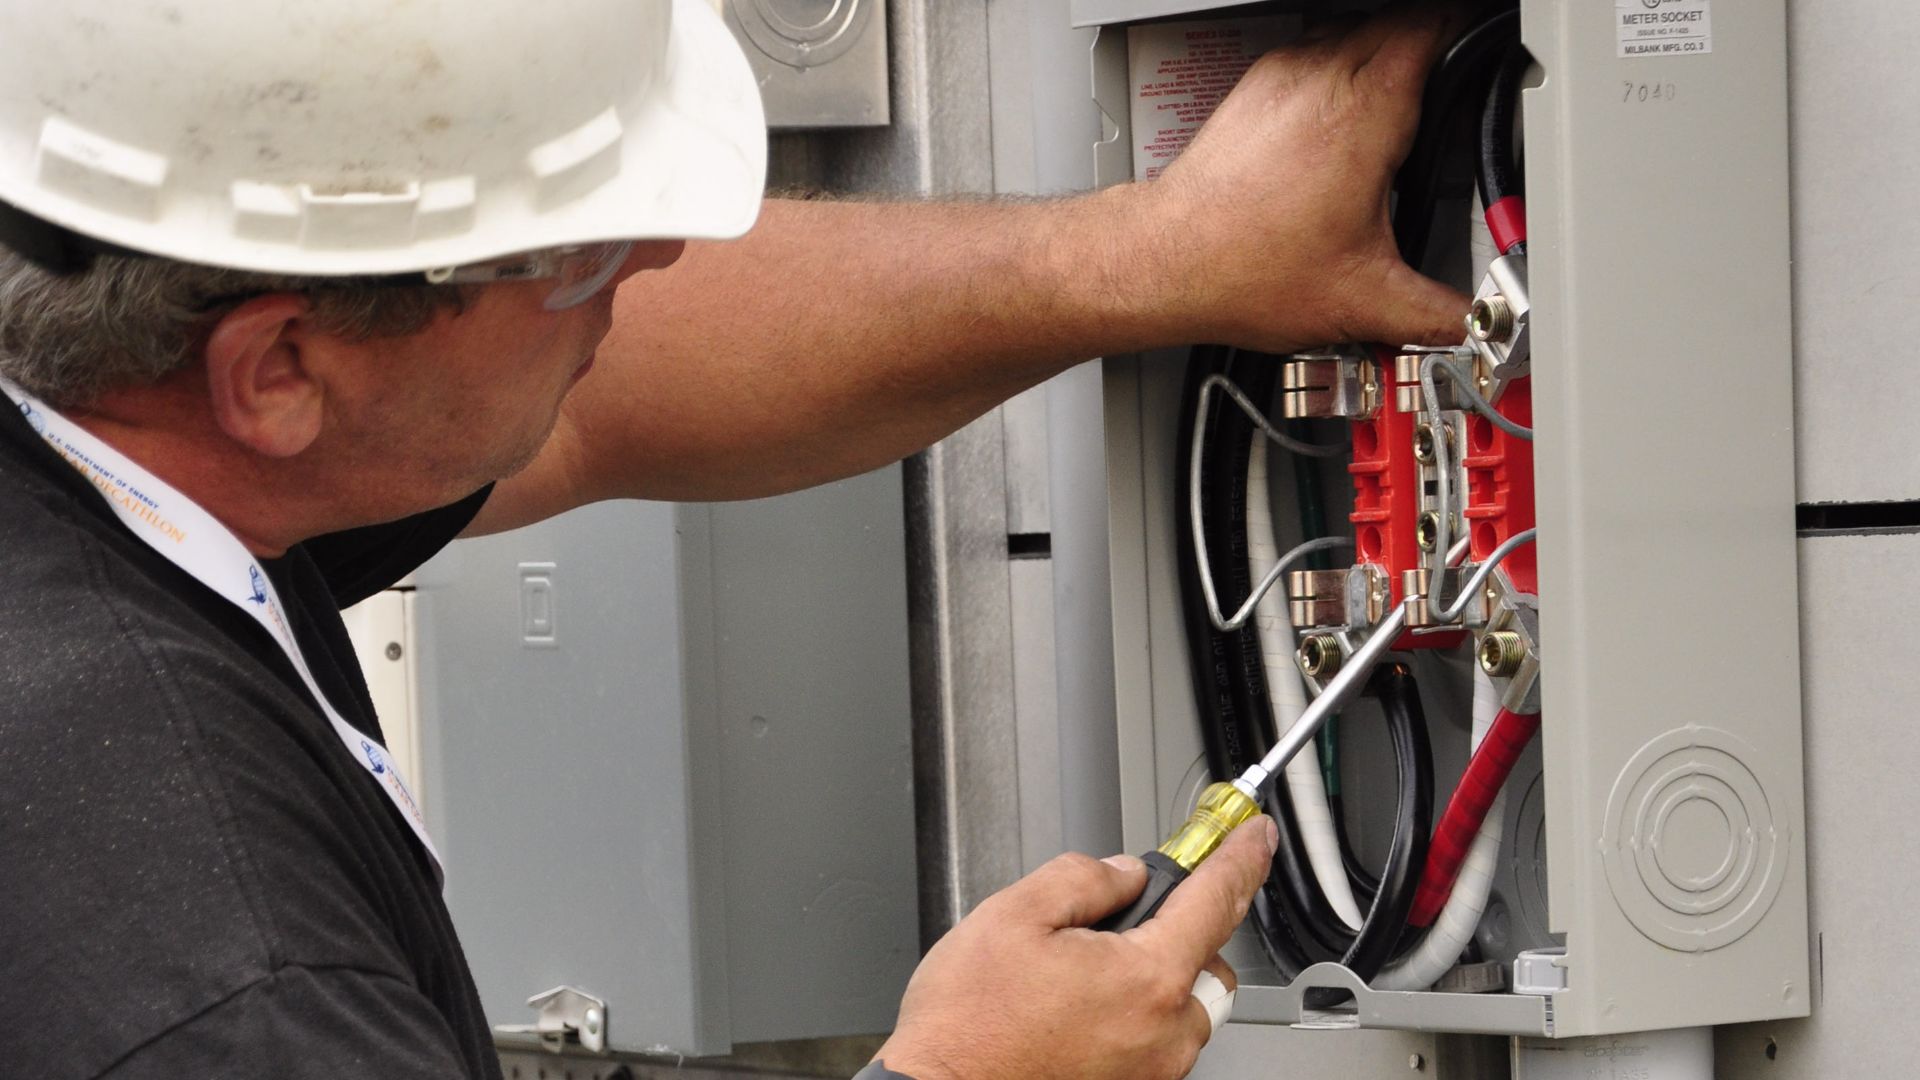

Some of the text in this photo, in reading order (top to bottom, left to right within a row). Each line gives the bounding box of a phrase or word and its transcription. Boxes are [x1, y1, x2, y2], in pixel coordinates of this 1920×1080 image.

[1623, 10, 1703, 24] METER SOCKET
[1625, 44, 1660, 54] MILBANK
[48, 433, 160, 509] U.S. DEPARTMENT OF ENERGY
[93, 474, 187, 544] DECATHLON
